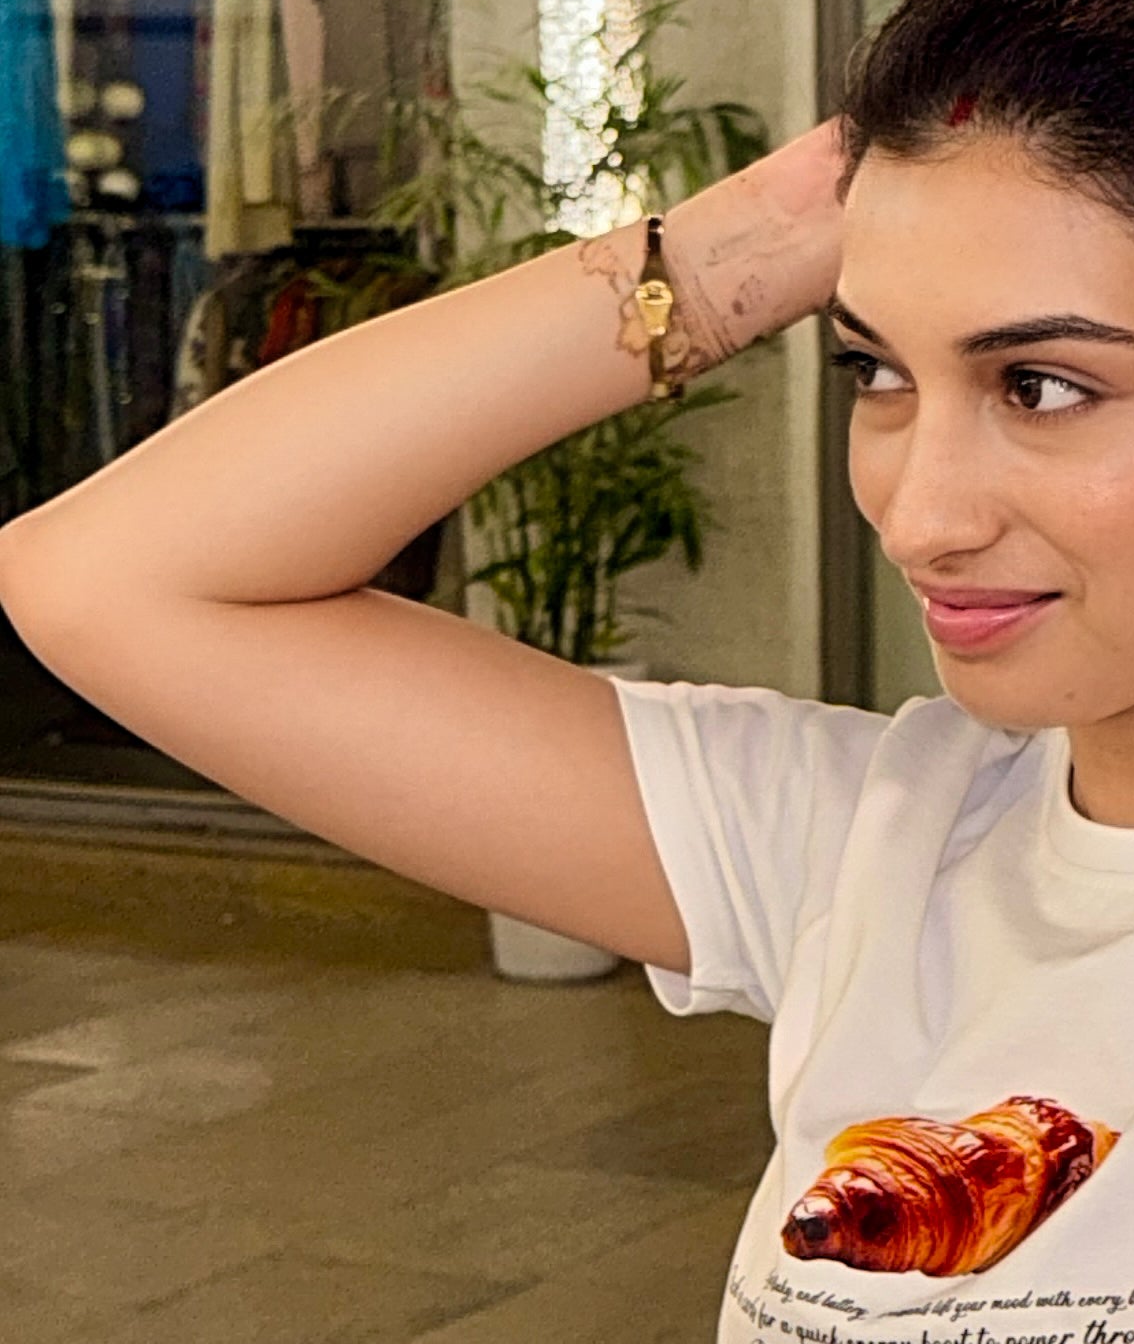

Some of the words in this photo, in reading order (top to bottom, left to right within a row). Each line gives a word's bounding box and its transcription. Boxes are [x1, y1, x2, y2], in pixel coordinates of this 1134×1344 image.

[950, 1300, 985, 1322] your
[990, 1290, 1033, 1310] mood
[1036, 1290, 1074, 1308] with
[1078, 1294, 1128, 1315] every
[780, 1320, 793, 1335] a
